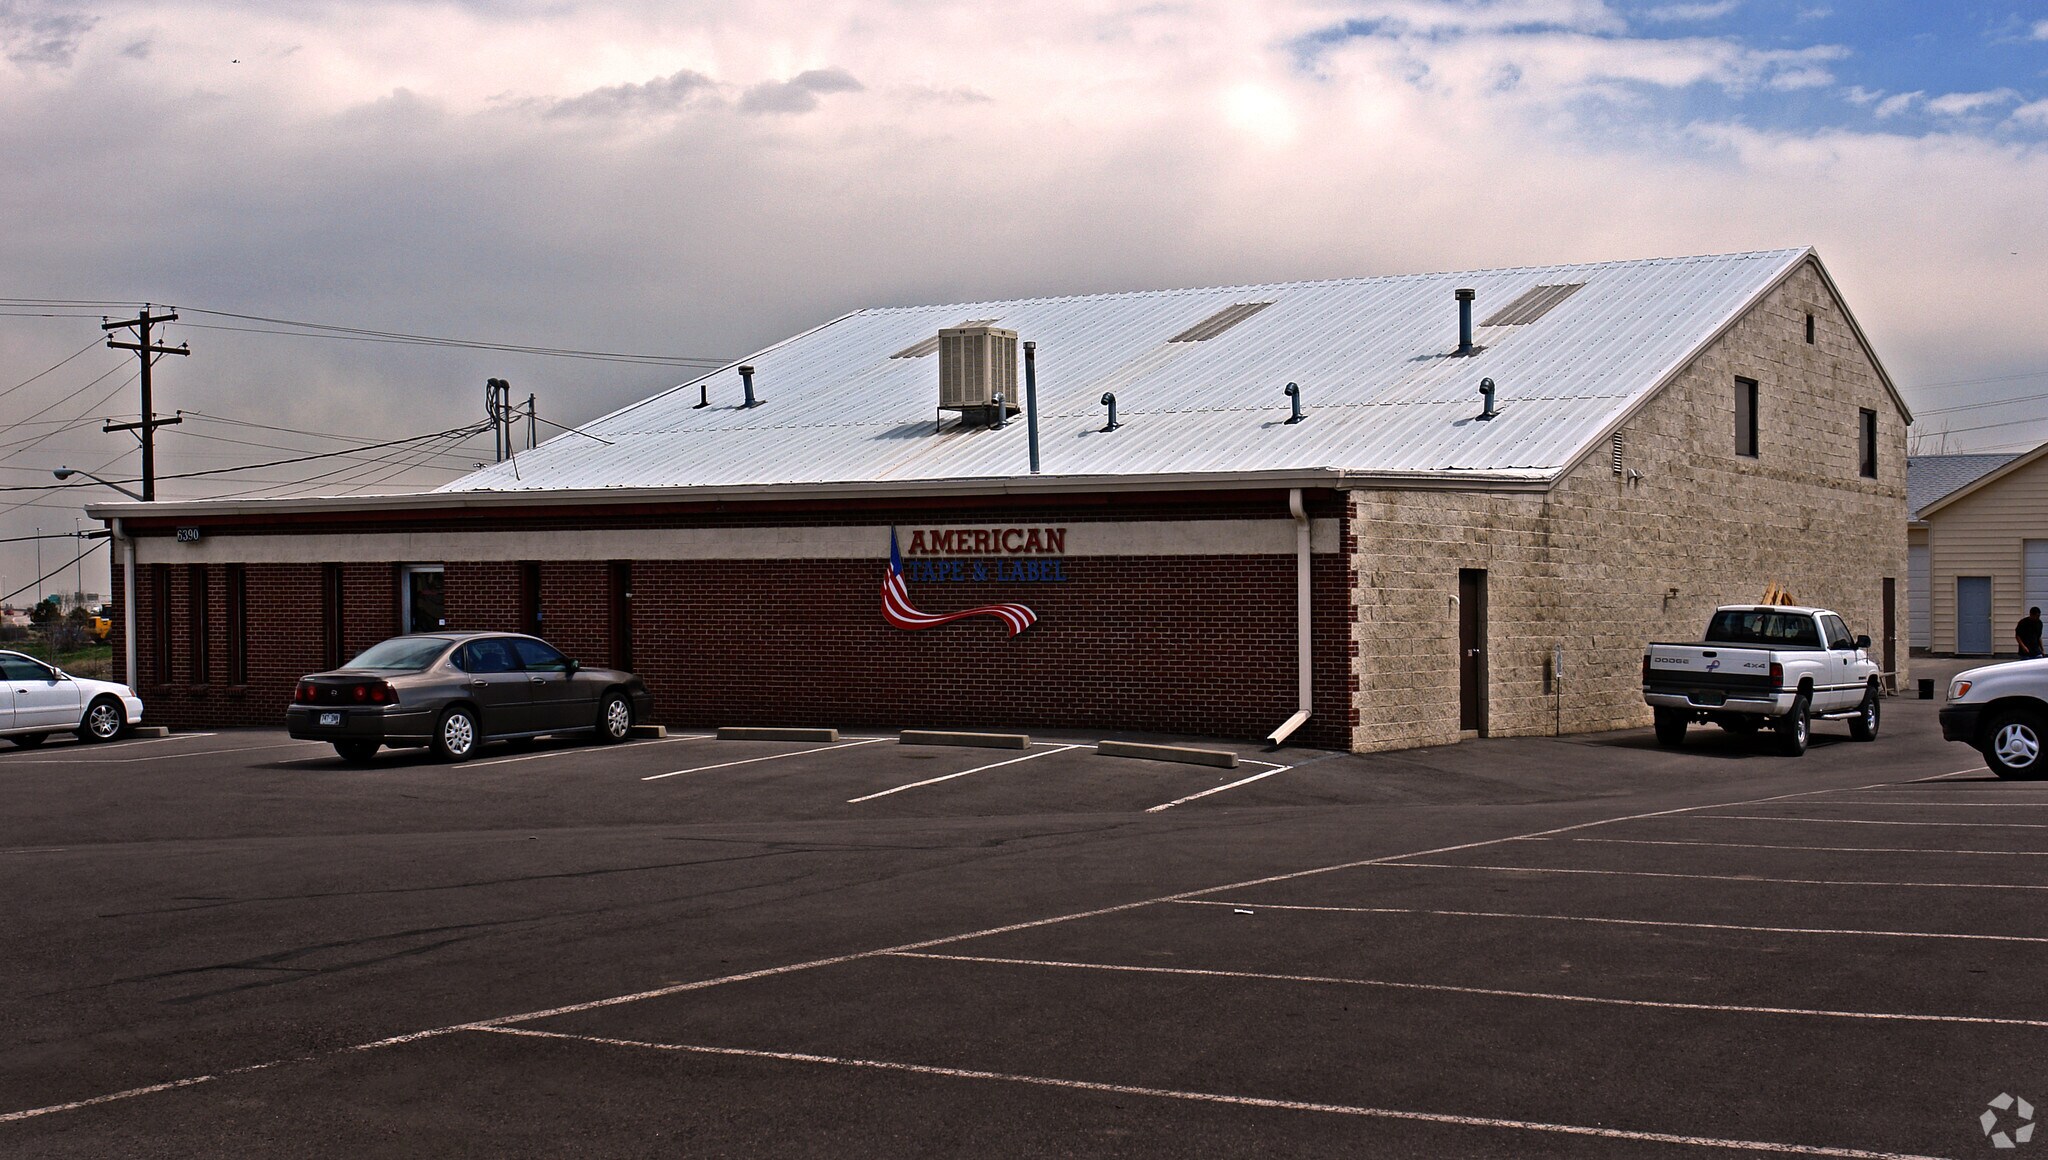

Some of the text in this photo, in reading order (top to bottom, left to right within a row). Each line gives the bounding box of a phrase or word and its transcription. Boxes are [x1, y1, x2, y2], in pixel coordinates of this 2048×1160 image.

[177, 529, 199, 541] 6390
[908, 528, 1067, 554] AMERICAN
[910, 559, 1067, 582] TAPE & LABEL
[1654, 657, 1689, 665] DODGE
